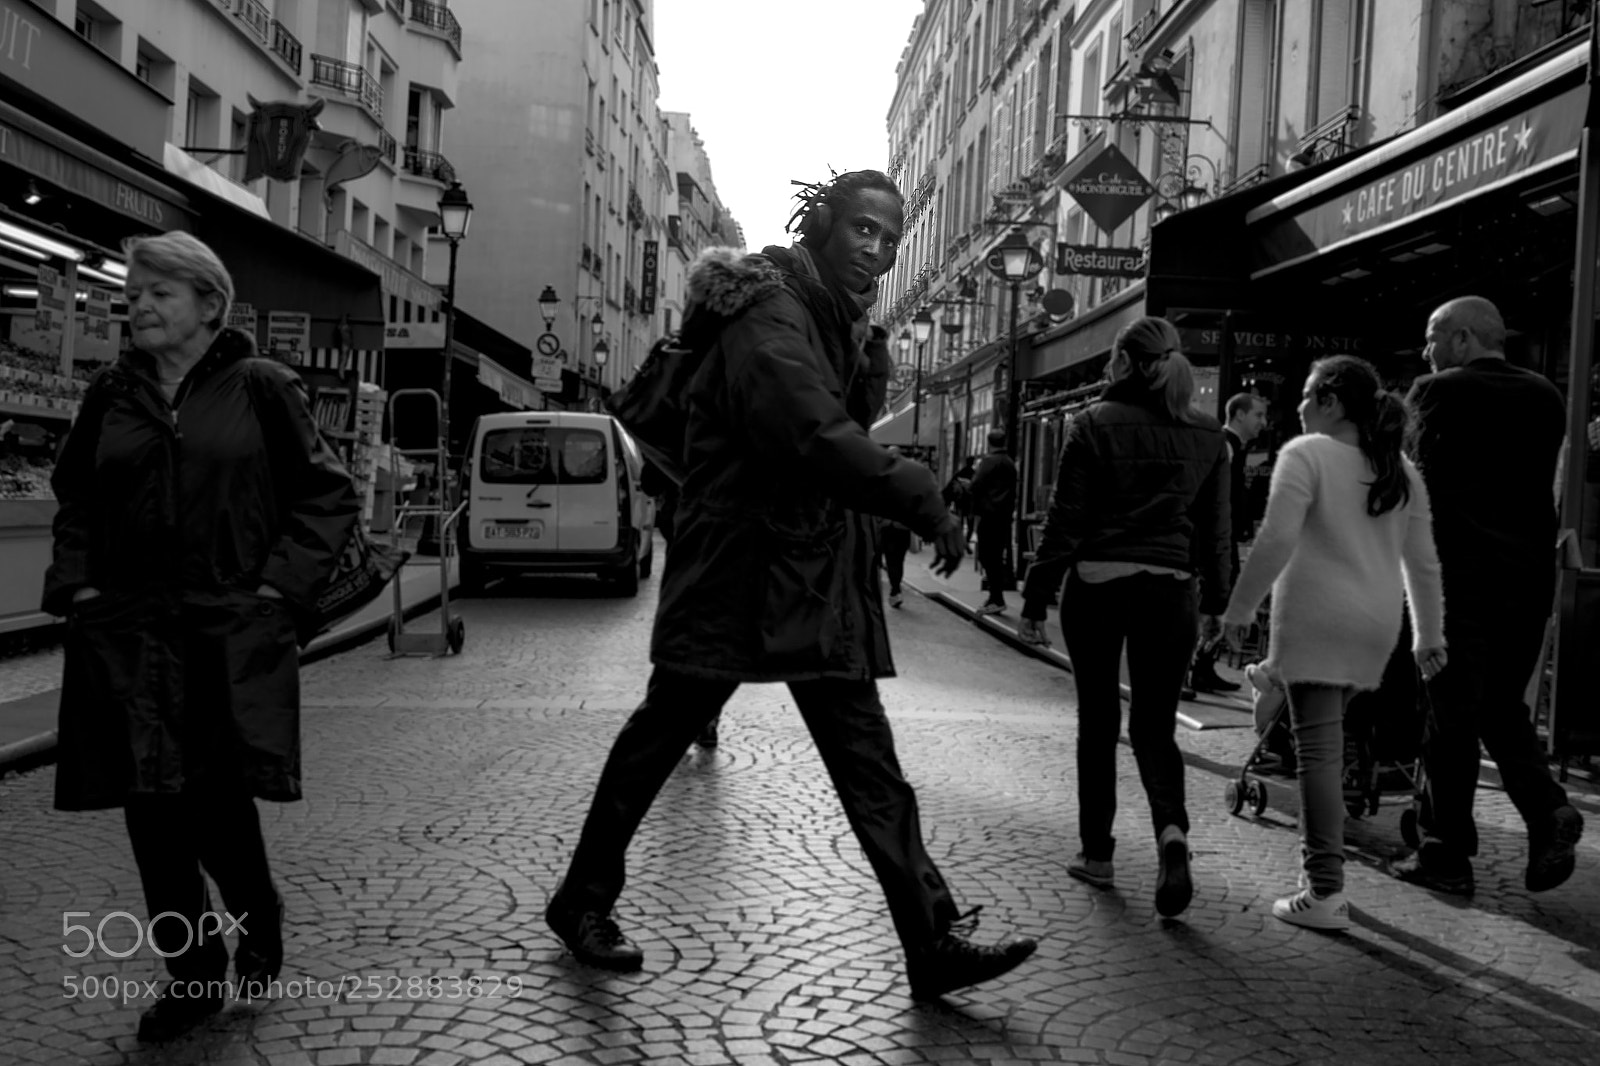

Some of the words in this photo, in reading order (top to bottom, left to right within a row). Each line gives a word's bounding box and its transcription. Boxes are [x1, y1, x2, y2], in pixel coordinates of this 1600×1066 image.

[116, 182, 163, 223] FRUITS
[1357, 177, 1396, 222] CAFE
[1402, 163, 1426, 205] DU
[1432, 125, 1509, 192] CENTRE
